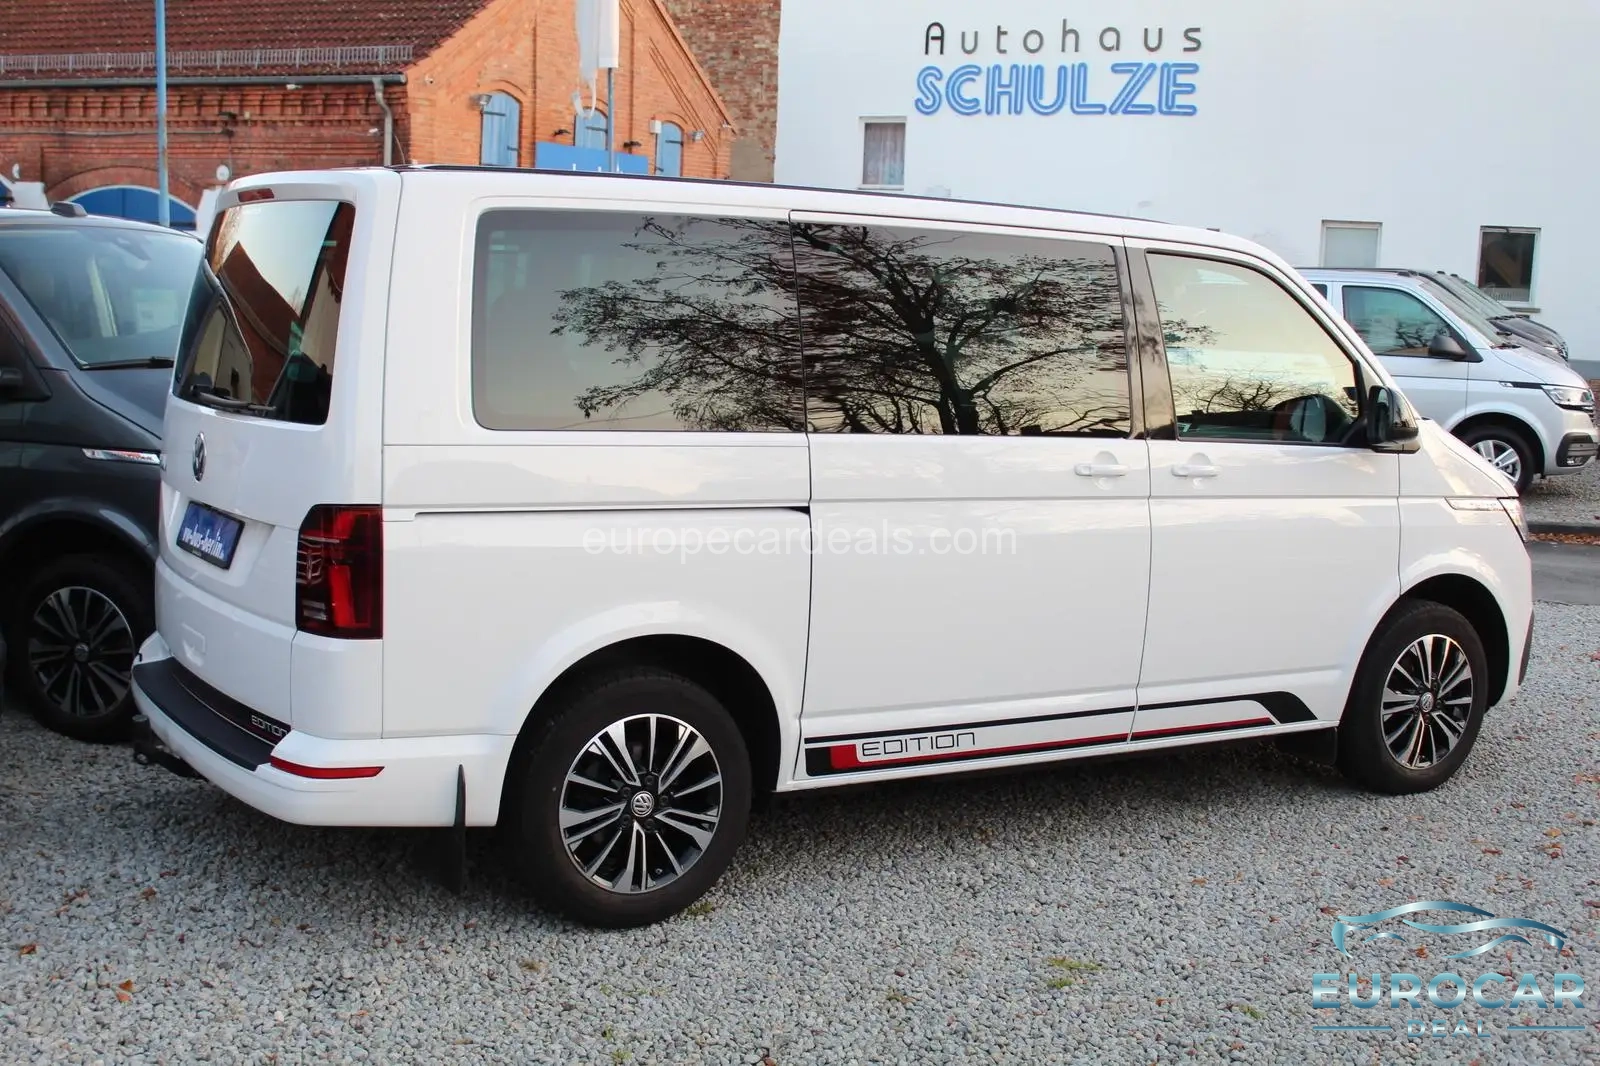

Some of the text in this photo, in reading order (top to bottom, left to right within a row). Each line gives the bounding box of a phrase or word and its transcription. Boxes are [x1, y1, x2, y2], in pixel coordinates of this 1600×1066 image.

[925, 18, 1202, 55] Autohaus
[915, 62, 1200, 116] SCHULZE
[251, 714, 288, 738] EDITION
[861, 731, 977, 757] EDITION
